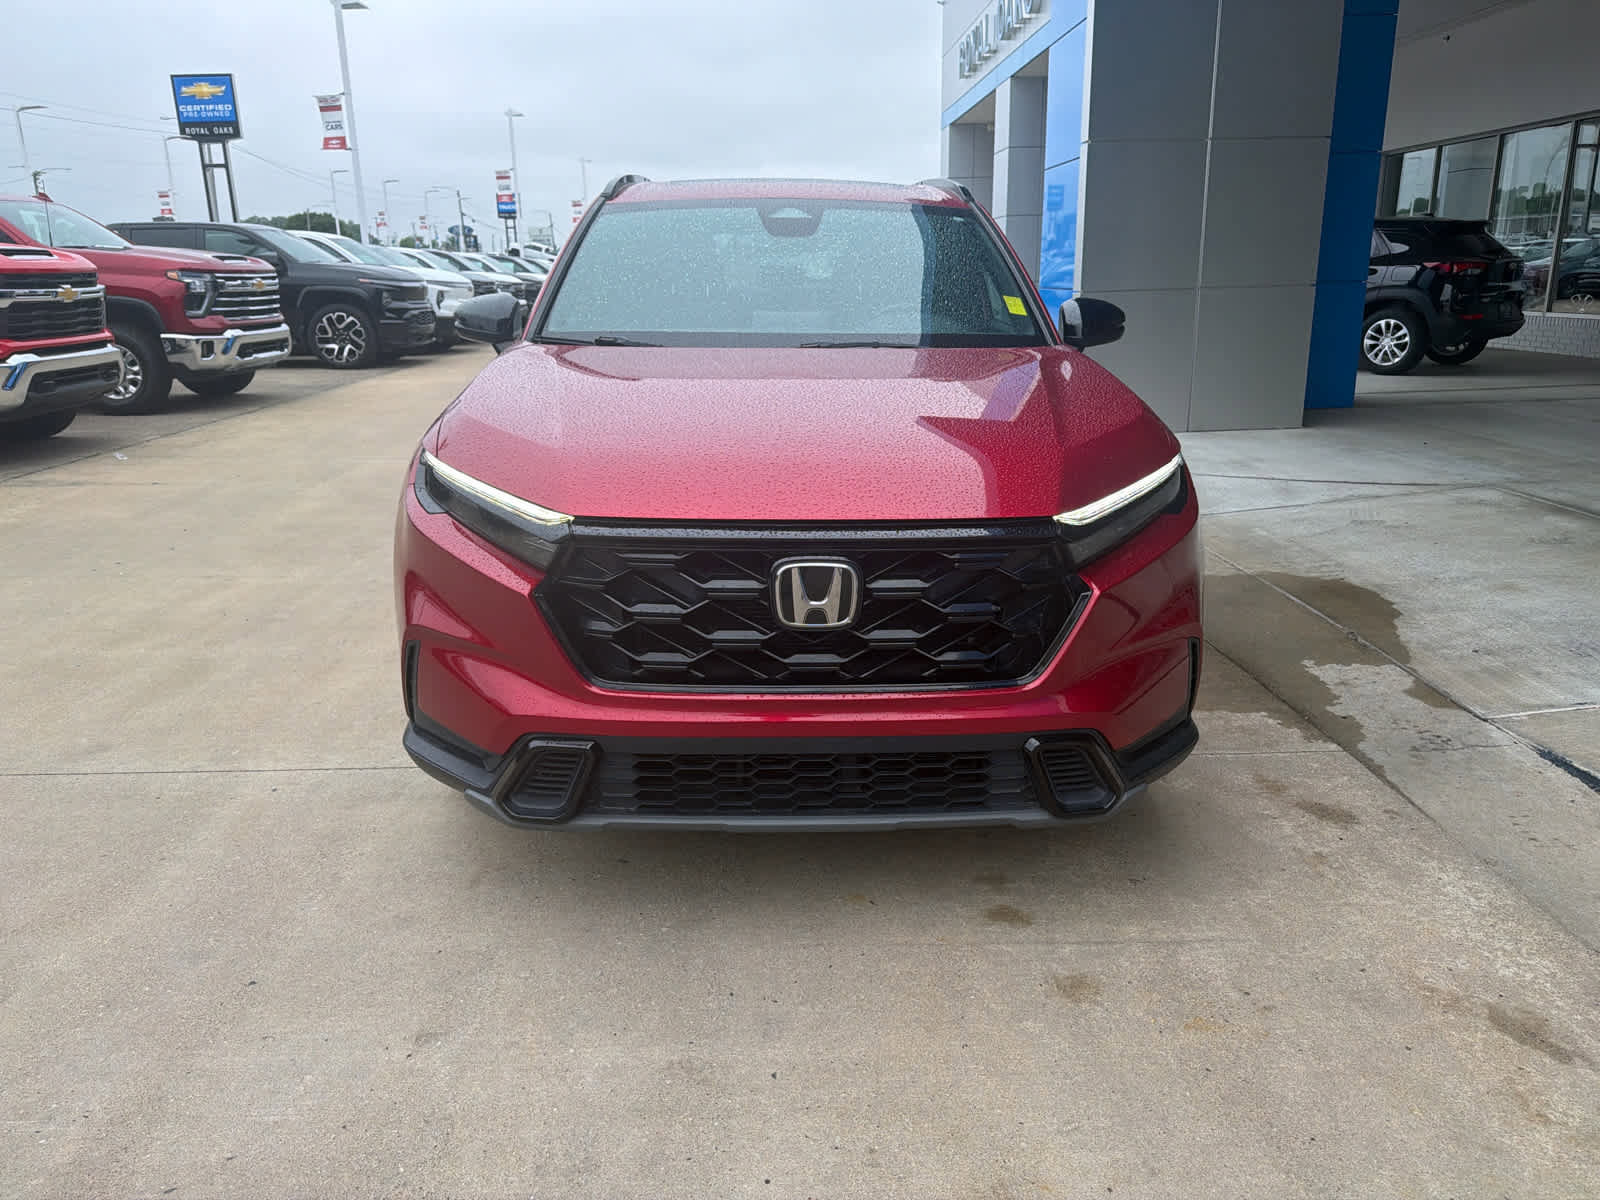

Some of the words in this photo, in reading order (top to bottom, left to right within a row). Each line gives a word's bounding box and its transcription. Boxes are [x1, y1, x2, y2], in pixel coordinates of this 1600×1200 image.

[959, 14, 992, 79] ROYAL
[179, 104, 232, 112] CERTIFIED
[185, 127, 210, 135] ROYAL
[213, 126, 233, 135] OAKS
[325, 123, 343, 131] CARS
